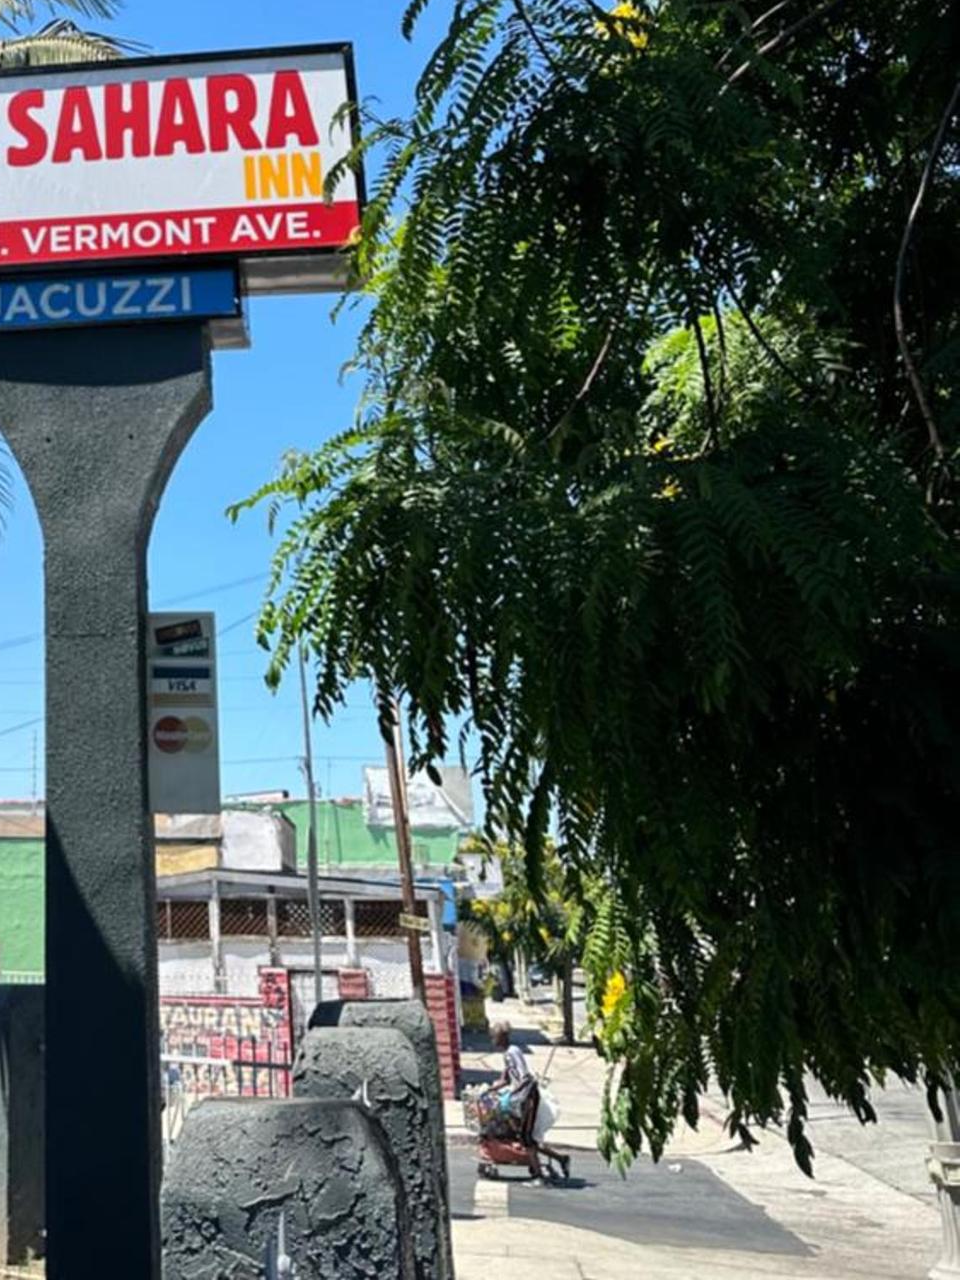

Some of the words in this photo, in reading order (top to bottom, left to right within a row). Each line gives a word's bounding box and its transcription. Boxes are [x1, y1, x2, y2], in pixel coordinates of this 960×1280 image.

[7, 69, 320, 167] SAHARA
[244, 152, 321, 200] INN
[21, 216, 217, 254] VERMONT
[230, 211, 321, 242] AVE.
[168, 680, 198, 691] VISA
